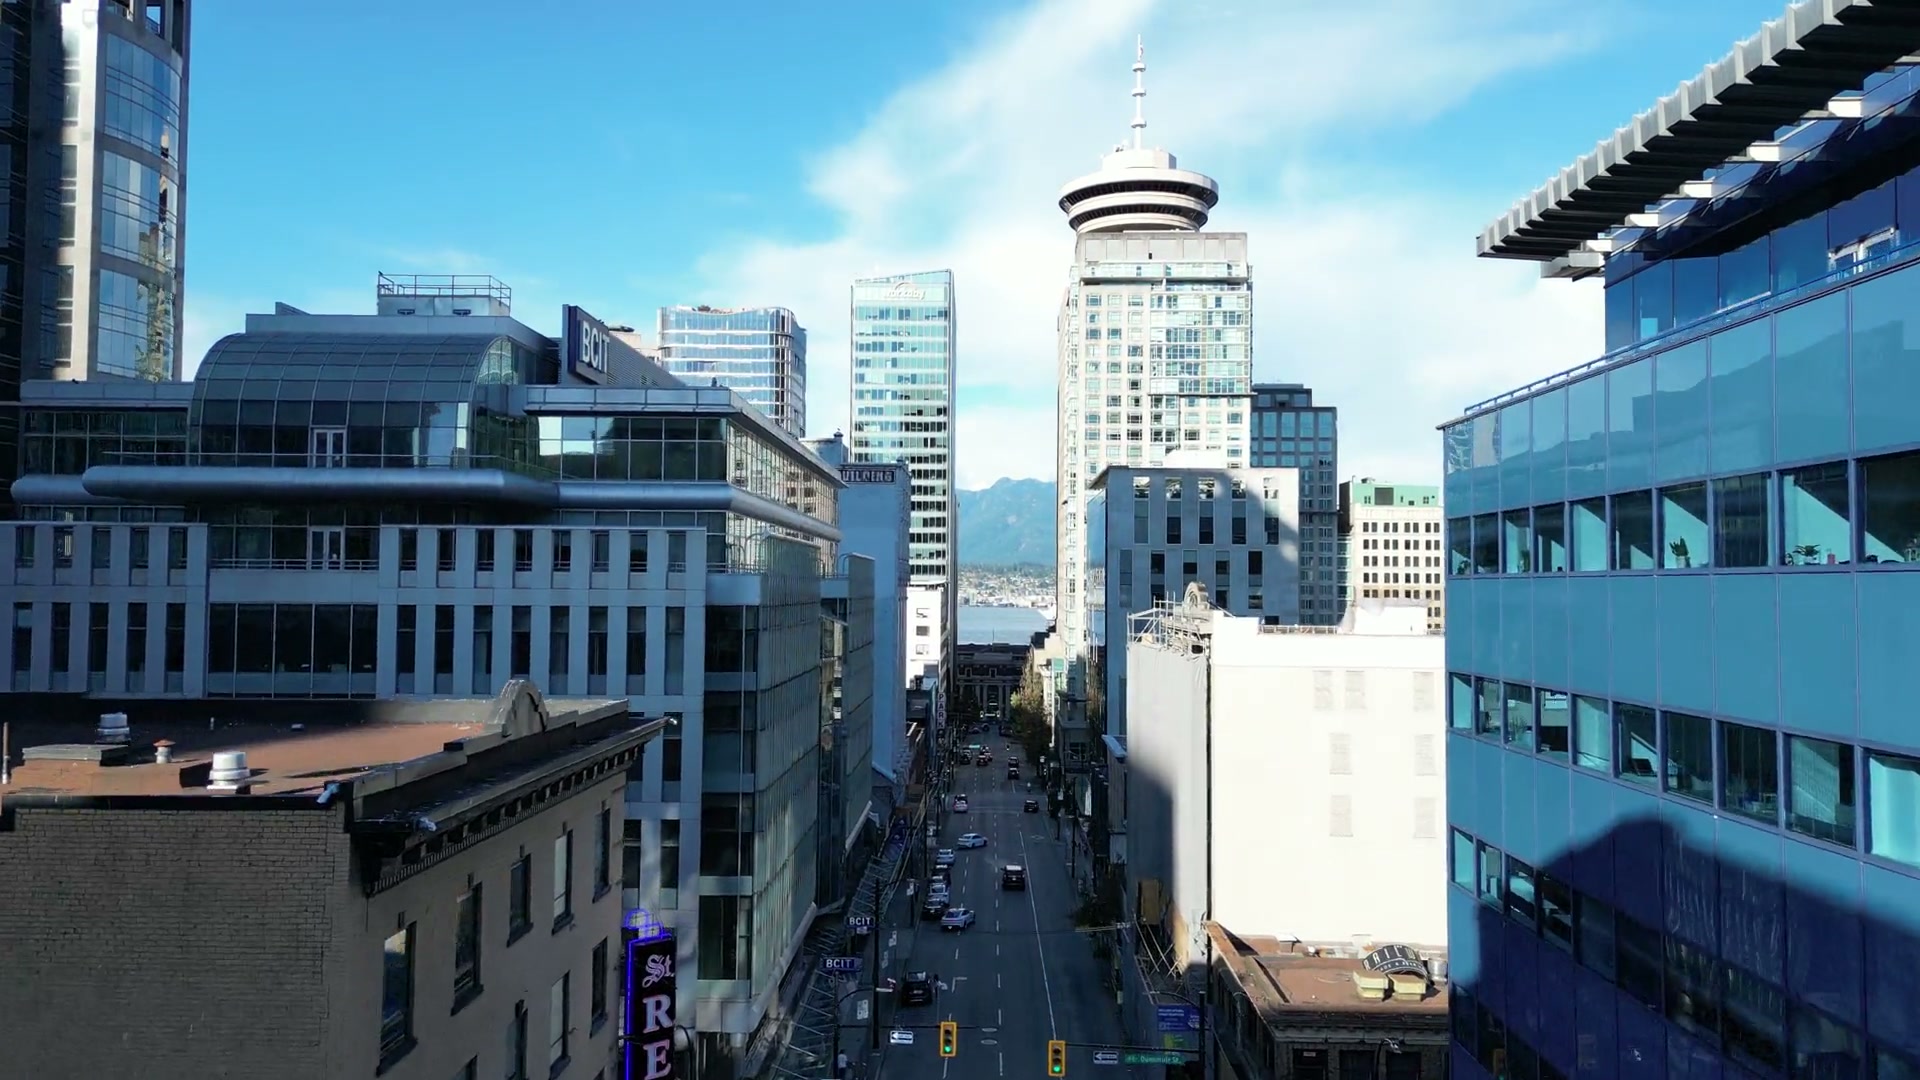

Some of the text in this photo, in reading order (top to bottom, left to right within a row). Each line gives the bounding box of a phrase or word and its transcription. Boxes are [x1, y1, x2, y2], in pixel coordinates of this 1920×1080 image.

[583, 320, 610, 373] BCIT
[849, 917, 871, 926] BCIT
[642, 954, 675, 988] St.
[826, 958, 852, 968] BCIT
